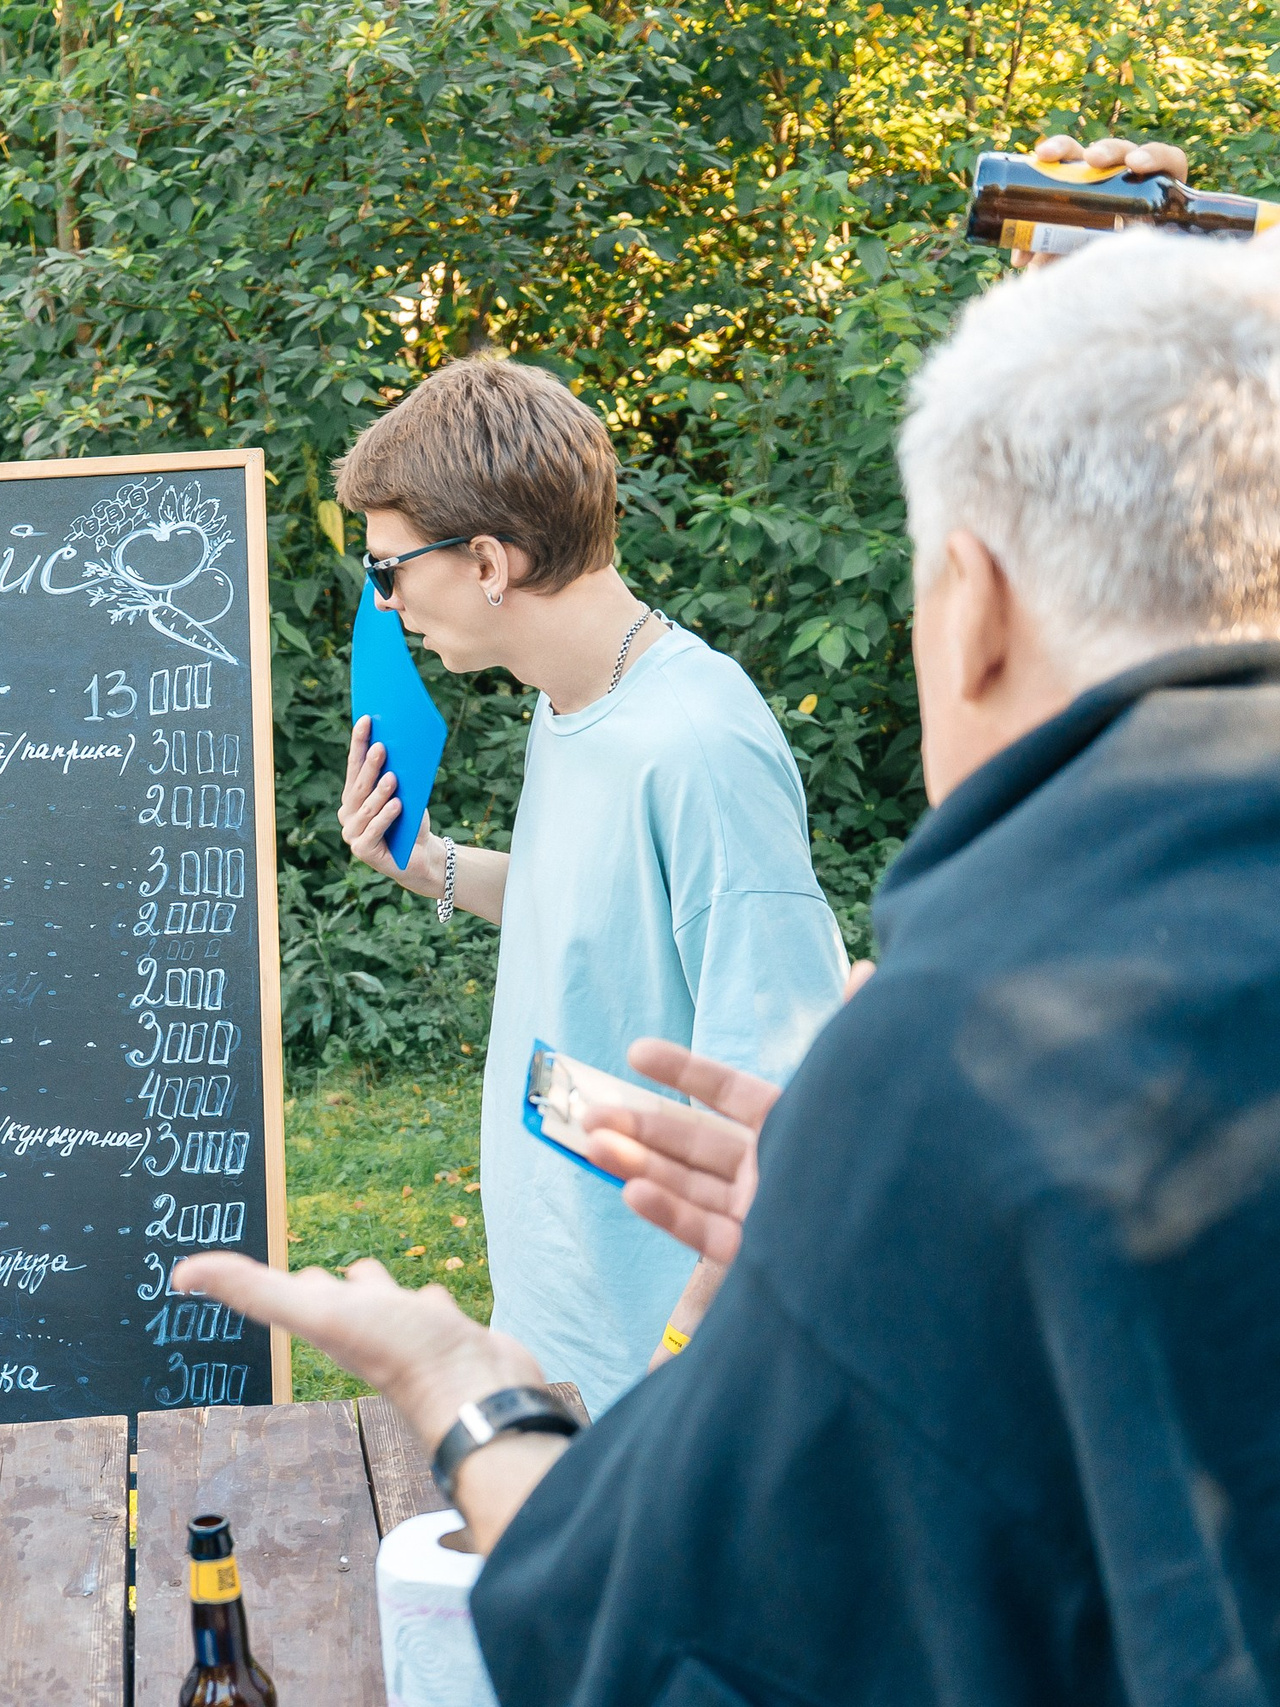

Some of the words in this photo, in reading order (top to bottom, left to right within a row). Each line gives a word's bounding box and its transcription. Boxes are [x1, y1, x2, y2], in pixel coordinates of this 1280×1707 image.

[138, 783, 245, 829] 2000
[132, 900, 237, 936] 2000
[129, 957, 225, 1010] 2000
[126, 1010, 241, 1068] 3000
[138, 1069, 237, 1120] 4000
[144, 1122, 250, 1177] 3000
[145, 1193, 245, 1244] 2000
